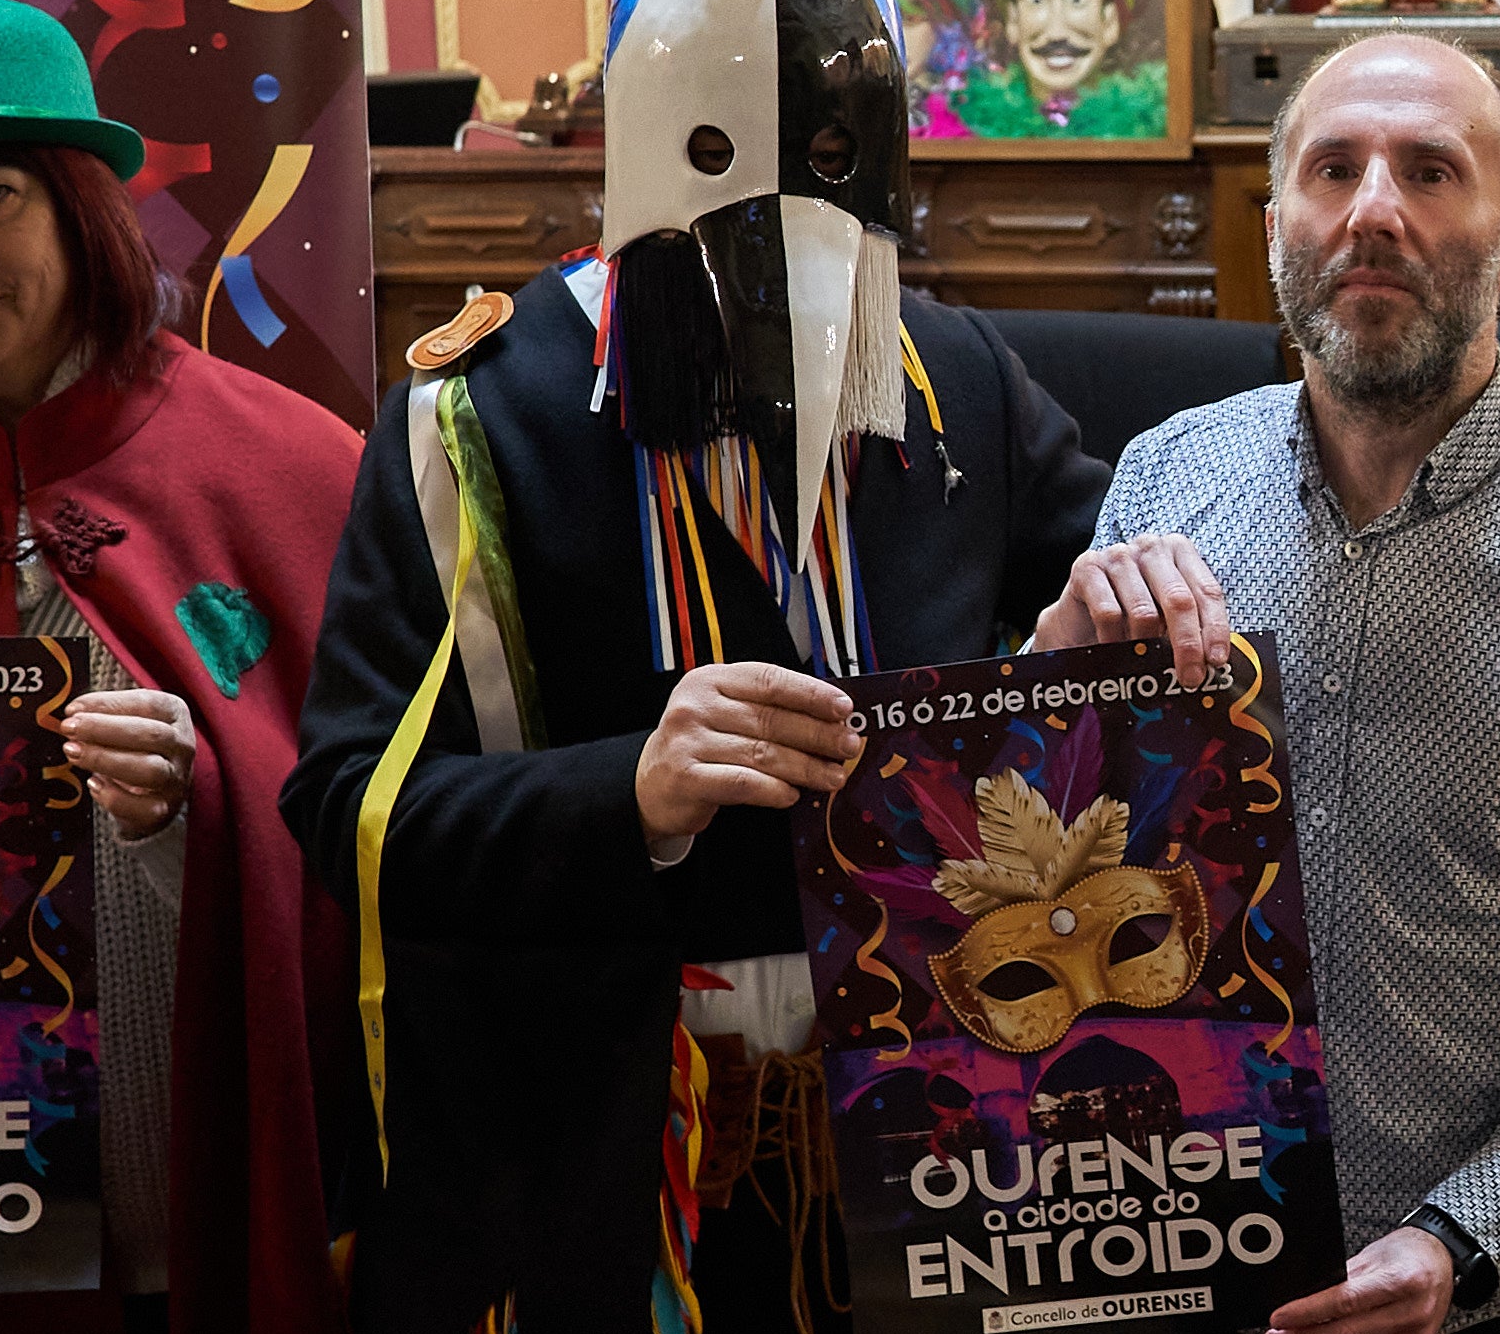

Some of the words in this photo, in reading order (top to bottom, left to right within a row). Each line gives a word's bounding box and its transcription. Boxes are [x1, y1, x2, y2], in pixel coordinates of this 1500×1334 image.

[846, 712, 867, 733] o
[871, 701, 906, 730] 16
[941, 692, 975, 722] 22
[982, 687, 1027, 714] de
[1032, 673, 1159, 709] febreiro
[1163, 663, 1234, 695] 223
[911, 1125, 1262, 1208] OURENSE
[983, 1209, 1008, 1232] a
[1017, 1193, 1143, 1227] cidade
[1152, 1189, 1200, 1216] do
[906, 1213, 1284, 1299] ENTROIDO
[1011, 1307, 1077, 1327] Concello
[1081, 1303, 1099, 1318] de
[1102, 1291, 1207, 1317] OURENSE
